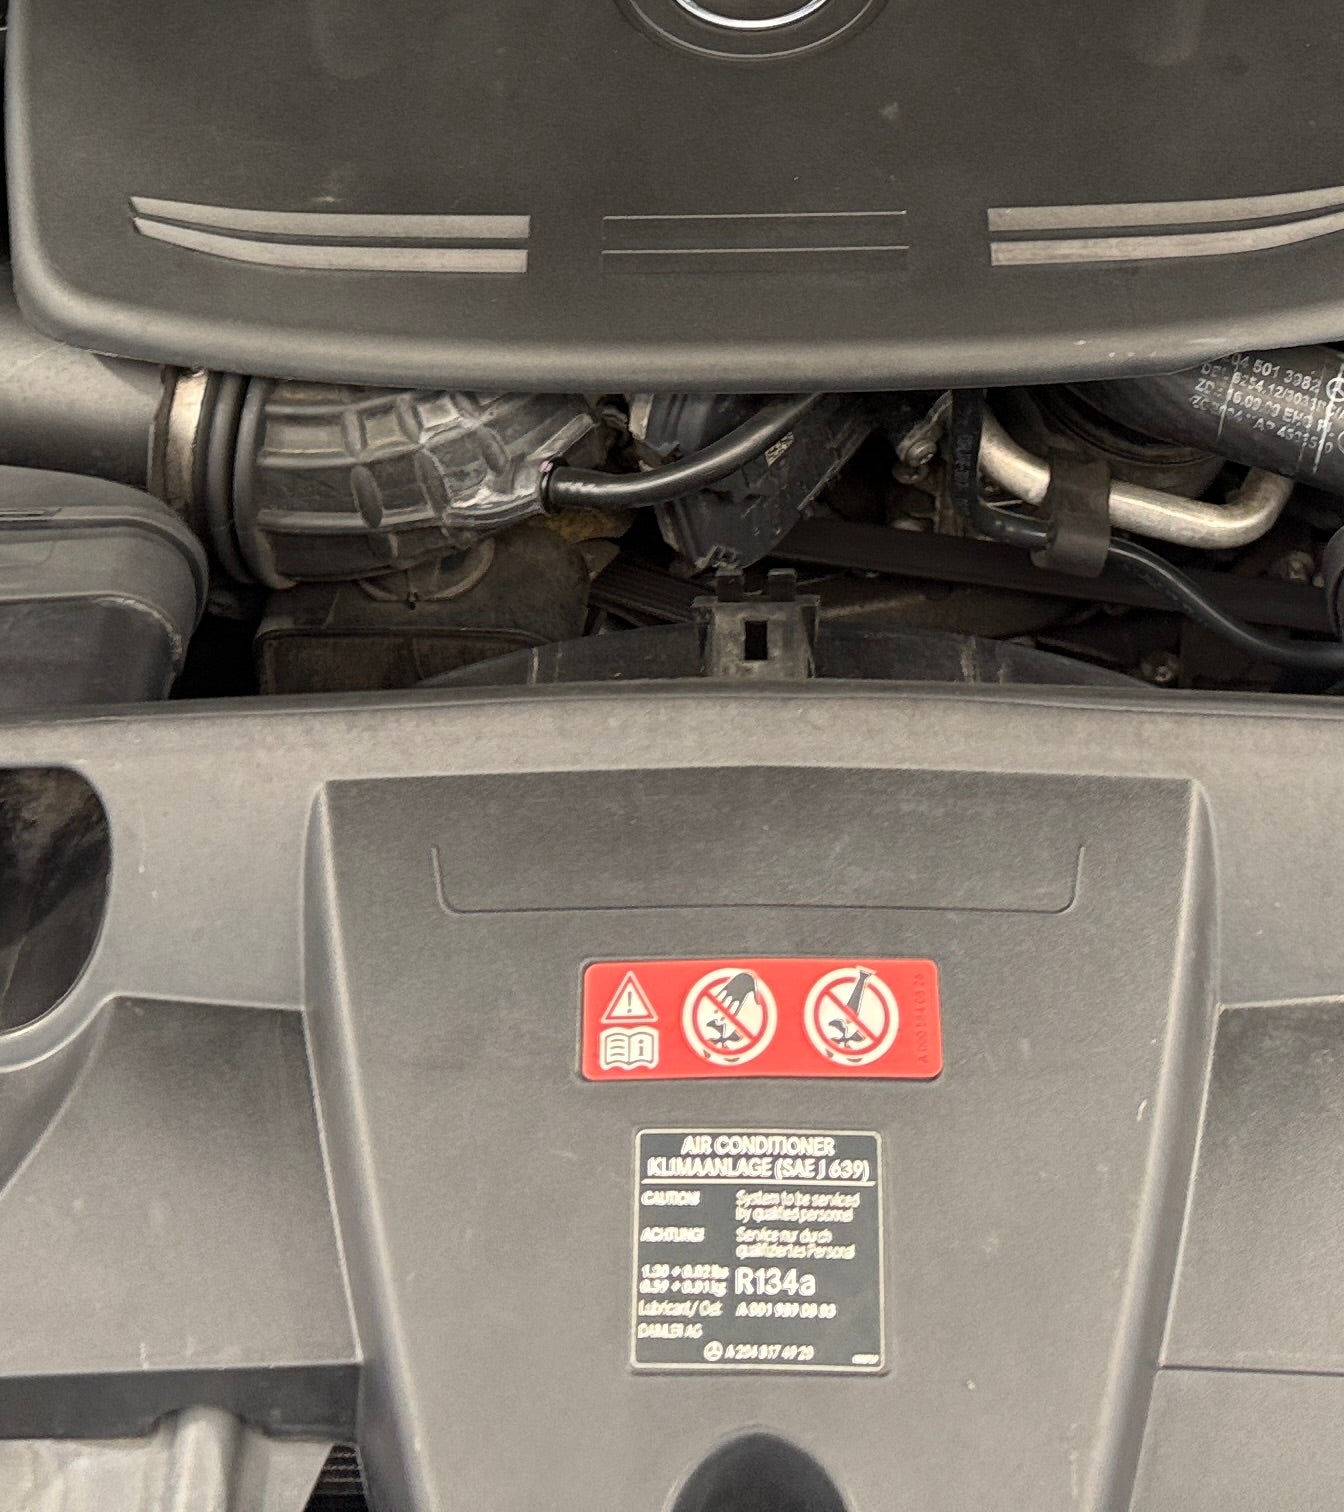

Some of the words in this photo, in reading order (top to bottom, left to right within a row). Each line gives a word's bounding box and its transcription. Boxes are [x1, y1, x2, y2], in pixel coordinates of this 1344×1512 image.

[1253, 359, 1280, 378] 501
[681, 1135, 712, 1156] AIR
[714, 1136, 835, 1157] CONDITIONER
[647, 1157, 772, 1178] KLIMAANLAGE
[774, 1158, 815, 1180] (SAE
[816, 1159, 826, 1180] J
[828, 1159, 870, 1182] 639)
[735, 1189, 780, 1207] System
[780, 1191, 794, 1206] to
[795, 1191, 811, 1207] be
[811, 1192, 860, 1208] serviced
[735, 1206, 752, 1223] by
[752, 1206, 799, 1223] qualified
[735, 1226, 779, 1242] Service
[806, 1243, 856, 1260] Personal
[734, 1266, 816, 1296] R134a
[735, 1301, 748, 1317] A
